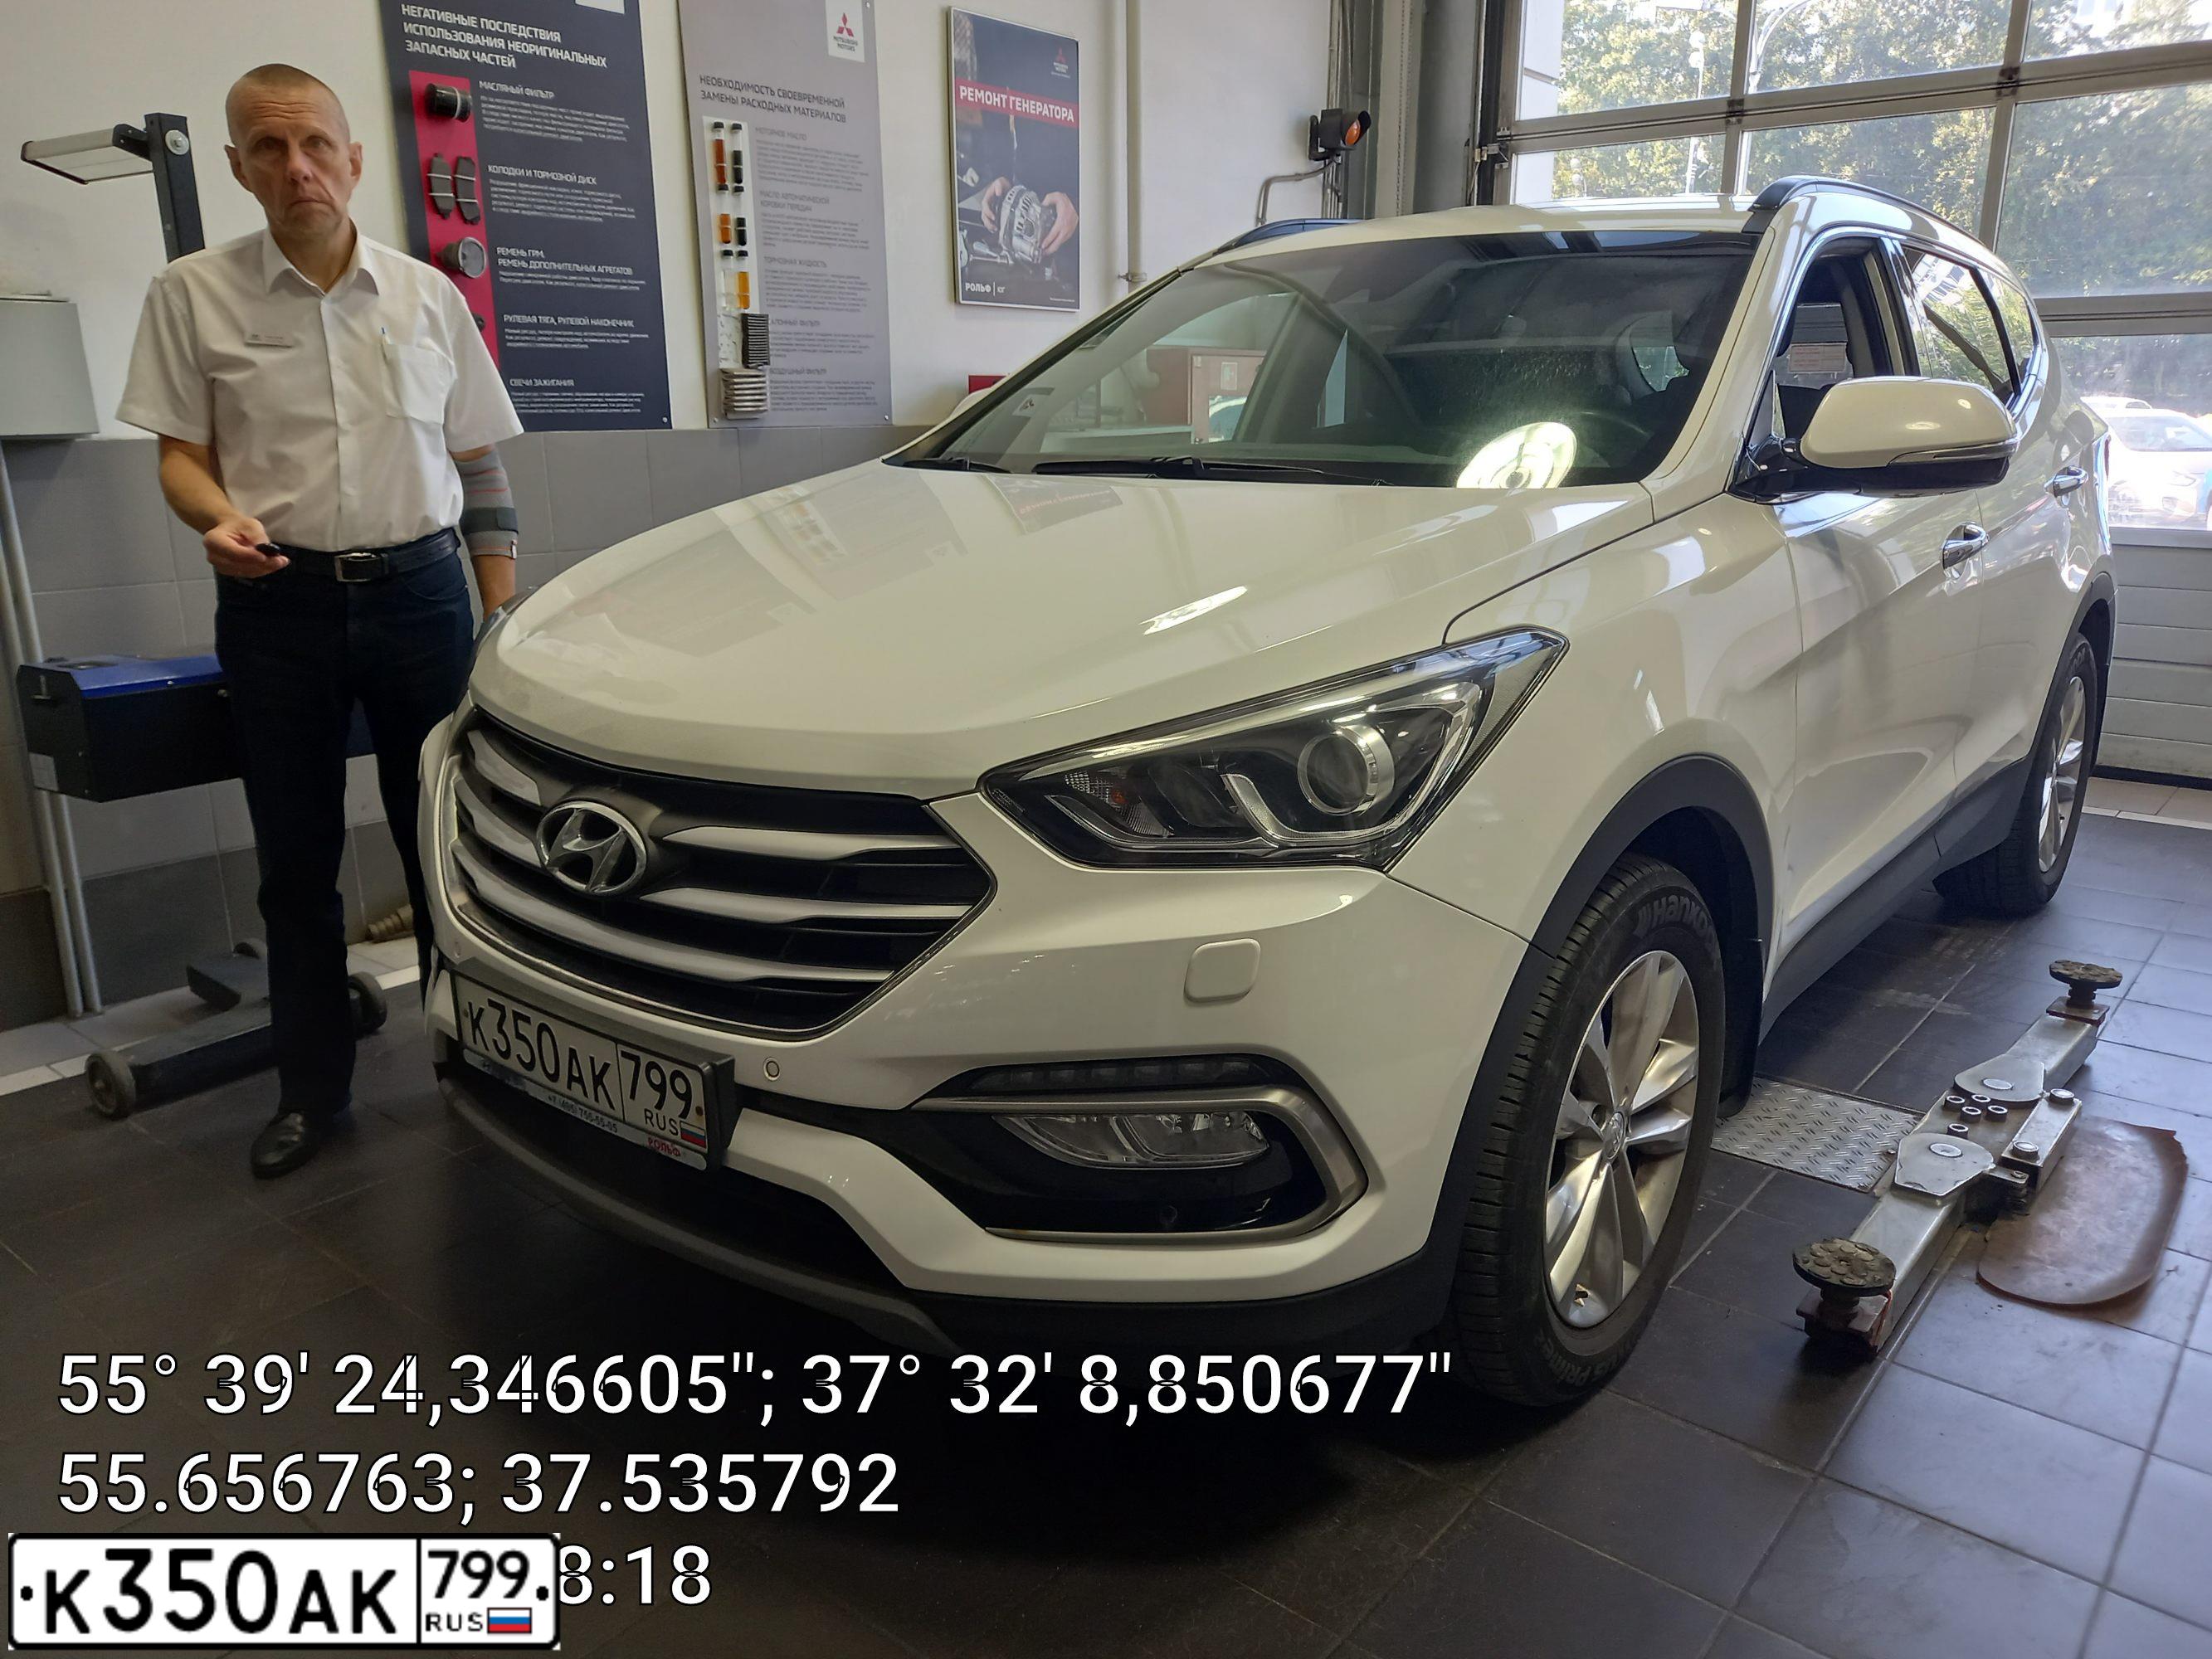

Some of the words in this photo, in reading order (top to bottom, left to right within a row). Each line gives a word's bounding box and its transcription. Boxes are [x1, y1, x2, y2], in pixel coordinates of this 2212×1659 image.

[402, 4, 478, 27] НЕГАТИВНЫЕ
[480, 18, 561, 42] ПОСЛЕДСТВИЯ
[403, 22, 505, 50] ИСПОЛЬЗОВАНИЯ
[508, 40, 607, 68] НЕОРИГИНАЛЬНЫХ
[405, 40, 470, 61] ЗАПАСНЫХ
[472, 51, 516, 68] ЧАСТЕЙ
[479, 80, 523, 95] МАСЛЯНЫЙ
[524, 88, 555, 100] ФИЛЬТР
[699, 75, 775, 96] НЕОБХОДИМОСТЬ
[777, 88, 845, 109] СВОЕВРЕМЕННОЙ
[959, 85, 1007, 109] РЕМОНТ
[1009, 92, 1074, 123] ГЕНЕРАТОРА
[700, 90, 738, 105] ЗАМЕНЫ
[741, 98, 792, 114] РАСХОДНЫХ
[794, 106, 846, 123] МАТЕРИАЛОВ
[488, 165, 524, 177] КОЛОДКИ
[534, 170, 577, 182] ТОРМОЗНОЙ
[577, 175, 597, 185] ДИСК
[497, 247, 527, 258] РЕМЕНЬ
[498, 259, 529, 268] РЕМЕНЬ
[529, 261, 597, 272] ДОПОЛНИТЕЛЬНЫХ
[965, 282, 992, 293] РОЛЬФ
[504, 314, 537, 324] РУЛЕВАЯ
[621, 1050, 693, 1120] 799
[644, 1108, 679, 1136] RUS
[647, 1137, 681, 1157] РОЛЬФ
